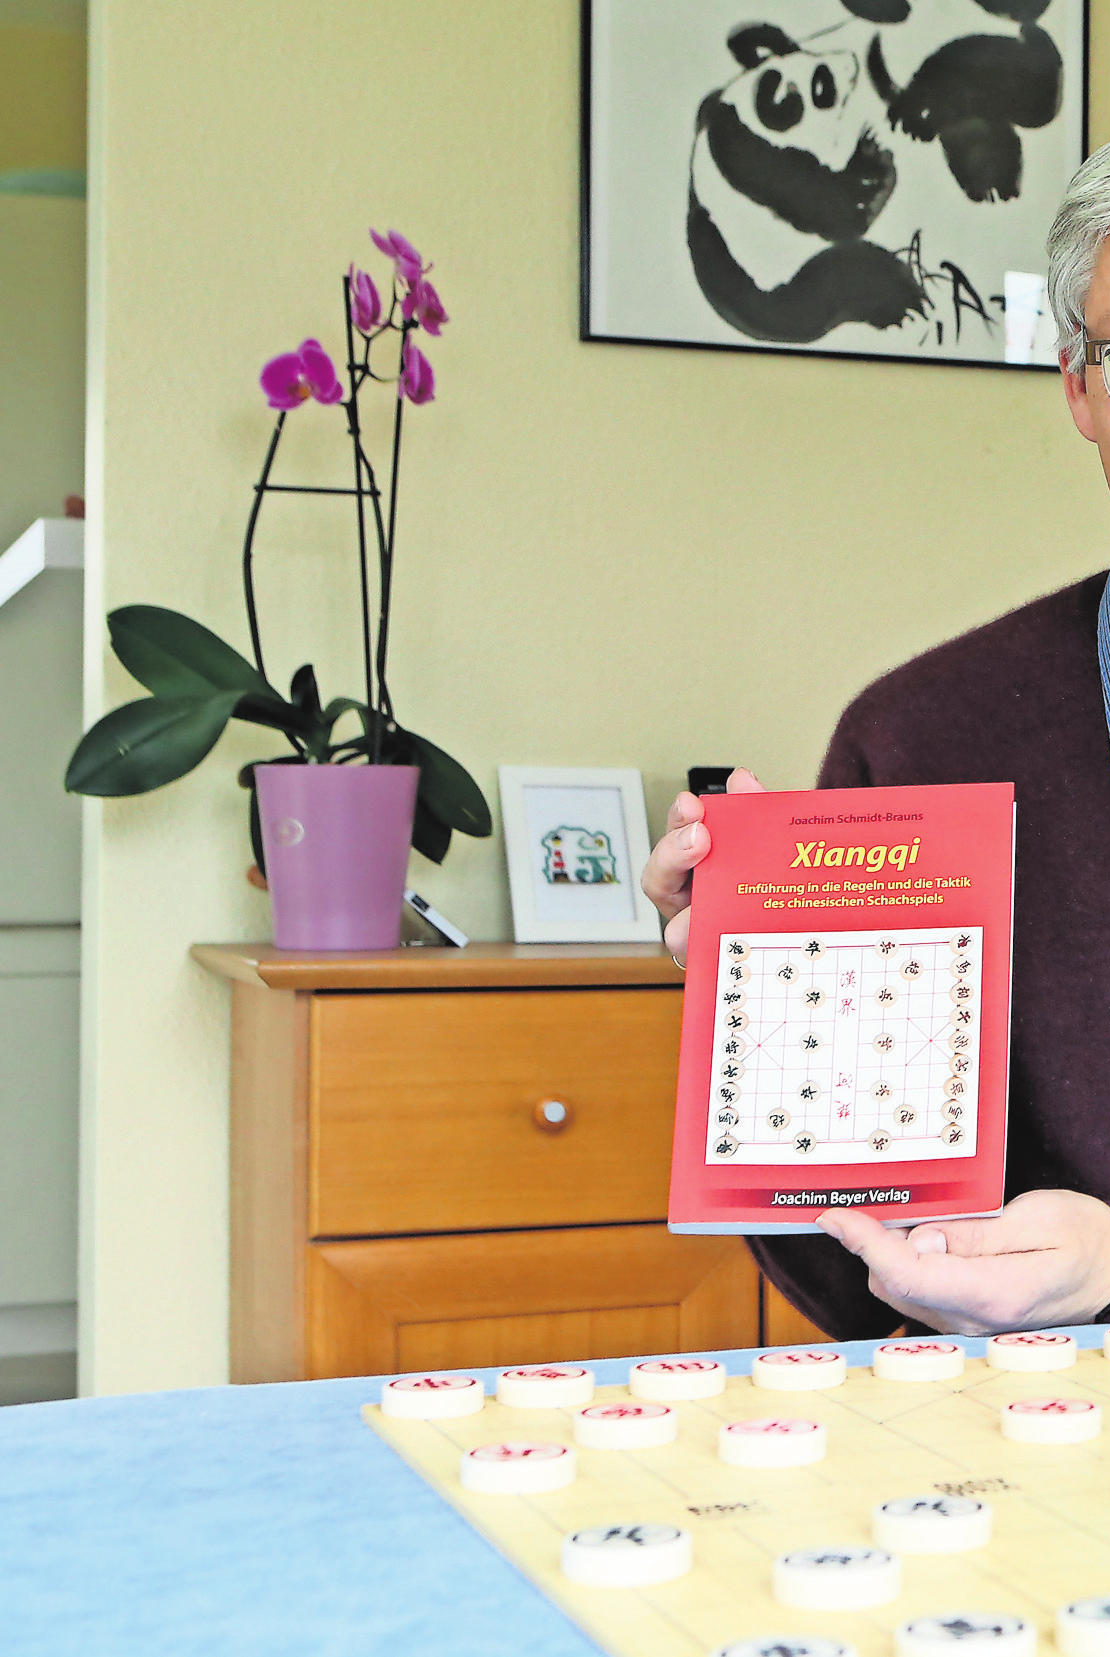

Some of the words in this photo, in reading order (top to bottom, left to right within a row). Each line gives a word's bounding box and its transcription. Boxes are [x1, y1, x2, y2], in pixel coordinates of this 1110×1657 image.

[789, 815, 835, 826] Joachim
[837, 812, 924, 824] Schmidt-Brauns
[789, 836, 921, 873] Xiangqi
[737, 881, 805, 895] Einführung
[808, 882, 819, 893] in
[822, 881, 841, 893] die
[844, 879, 885, 893] Regeln
[888, 878, 912, 890] und
[914, 878, 933, 889] die
[935, 876, 971, 888] Taktik
[763, 898, 785, 909] des
[787, 896, 865, 909] chinesischen
[867, 893, 944, 907] Schachspiels
[771, 1191, 827, 1205] Joachim
[830, 1191, 867, 1206] Beyer
[869, 1188, 910, 1204] Verlag
